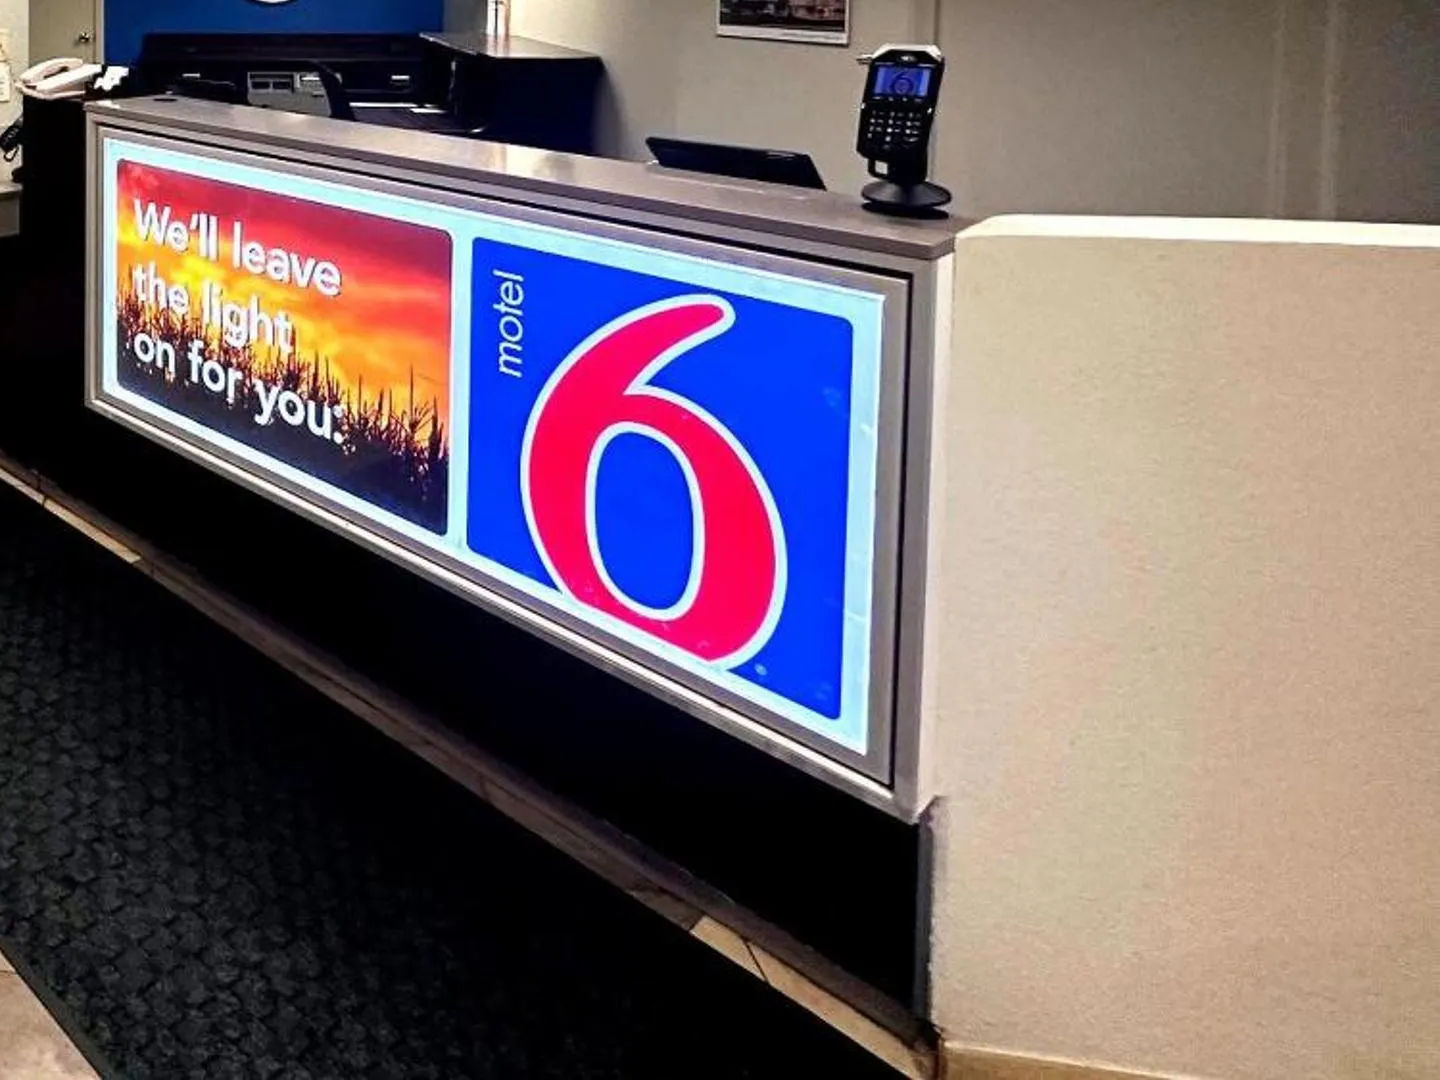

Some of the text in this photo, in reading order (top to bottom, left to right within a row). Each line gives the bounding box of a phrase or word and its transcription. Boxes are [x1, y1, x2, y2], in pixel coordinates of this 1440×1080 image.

[133, 198, 342, 297] We'll leave
[132, 262, 294, 354] the light
[492, 268, 525, 378] motel
[133, 332, 176, 376] on
[187, 338, 243, 403] for
[520, 293, 788, 672] 6
